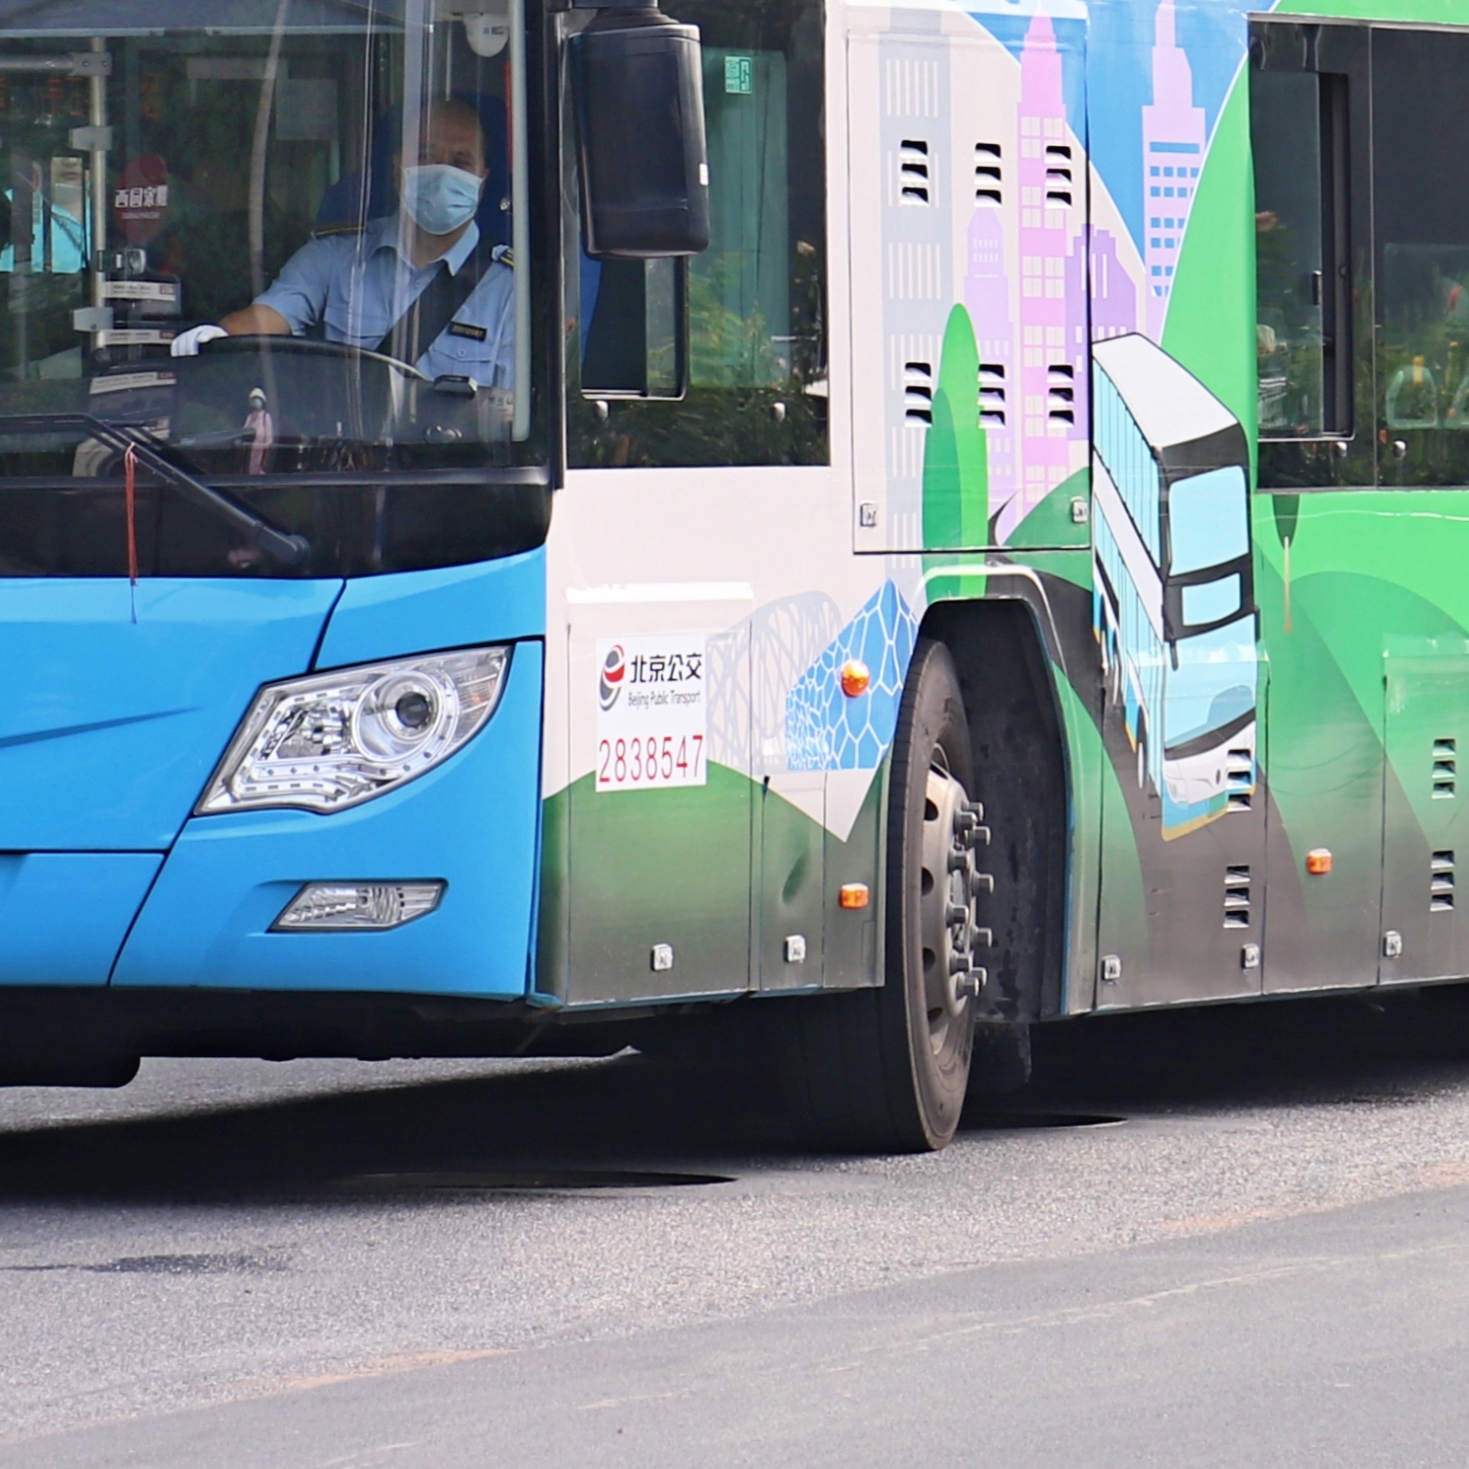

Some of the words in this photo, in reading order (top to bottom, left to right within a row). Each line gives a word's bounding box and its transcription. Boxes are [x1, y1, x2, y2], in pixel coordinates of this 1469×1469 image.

[630, 653, 702, 683] 北京公交
[599, 735, 703, 782] 2838547
